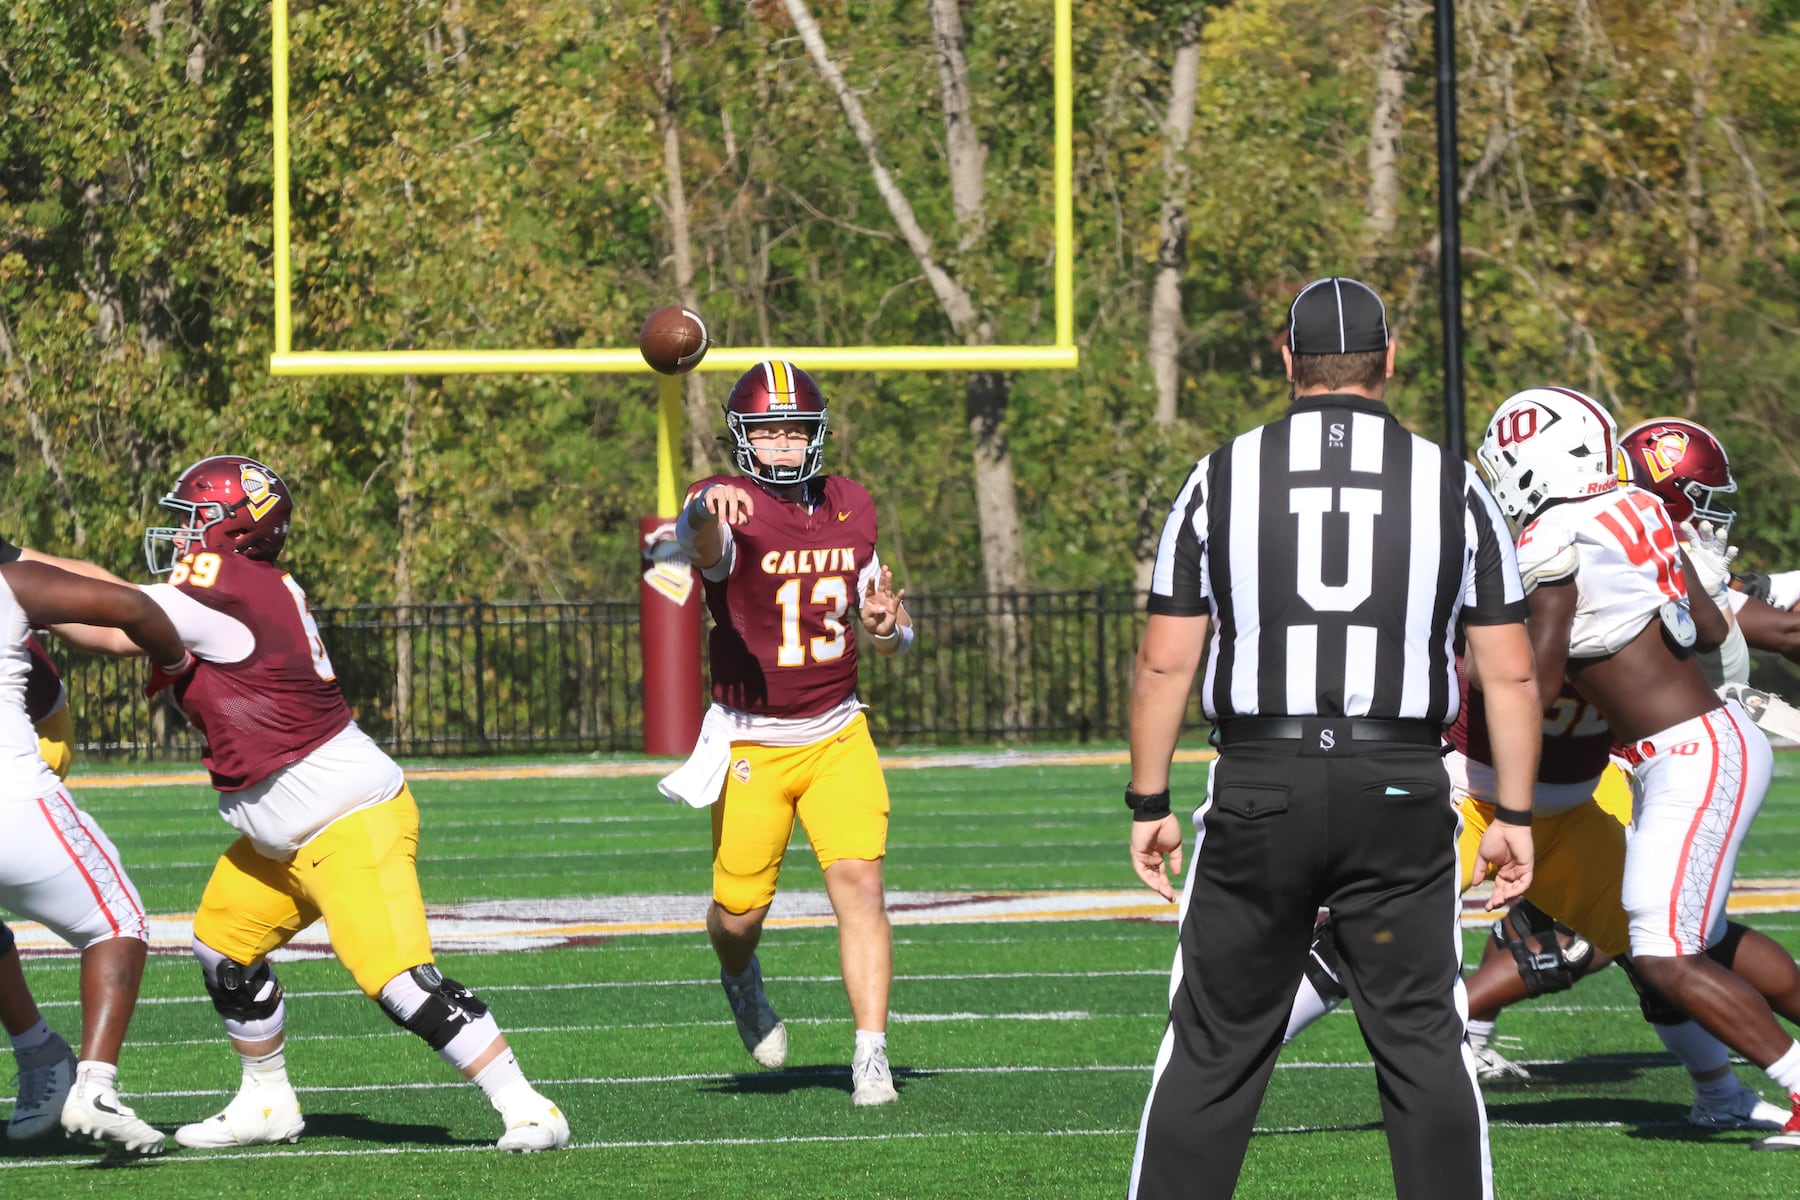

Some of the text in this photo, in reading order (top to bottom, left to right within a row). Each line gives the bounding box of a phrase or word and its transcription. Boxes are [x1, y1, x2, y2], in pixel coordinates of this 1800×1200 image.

[1496, 408, 1537, 447] UO
[761, 548, 855, 574] CALVIN
[1289, 487, 1382, 611] U
[168, 552, 222, 588] 69
[775, 576, 848, 667] 13
